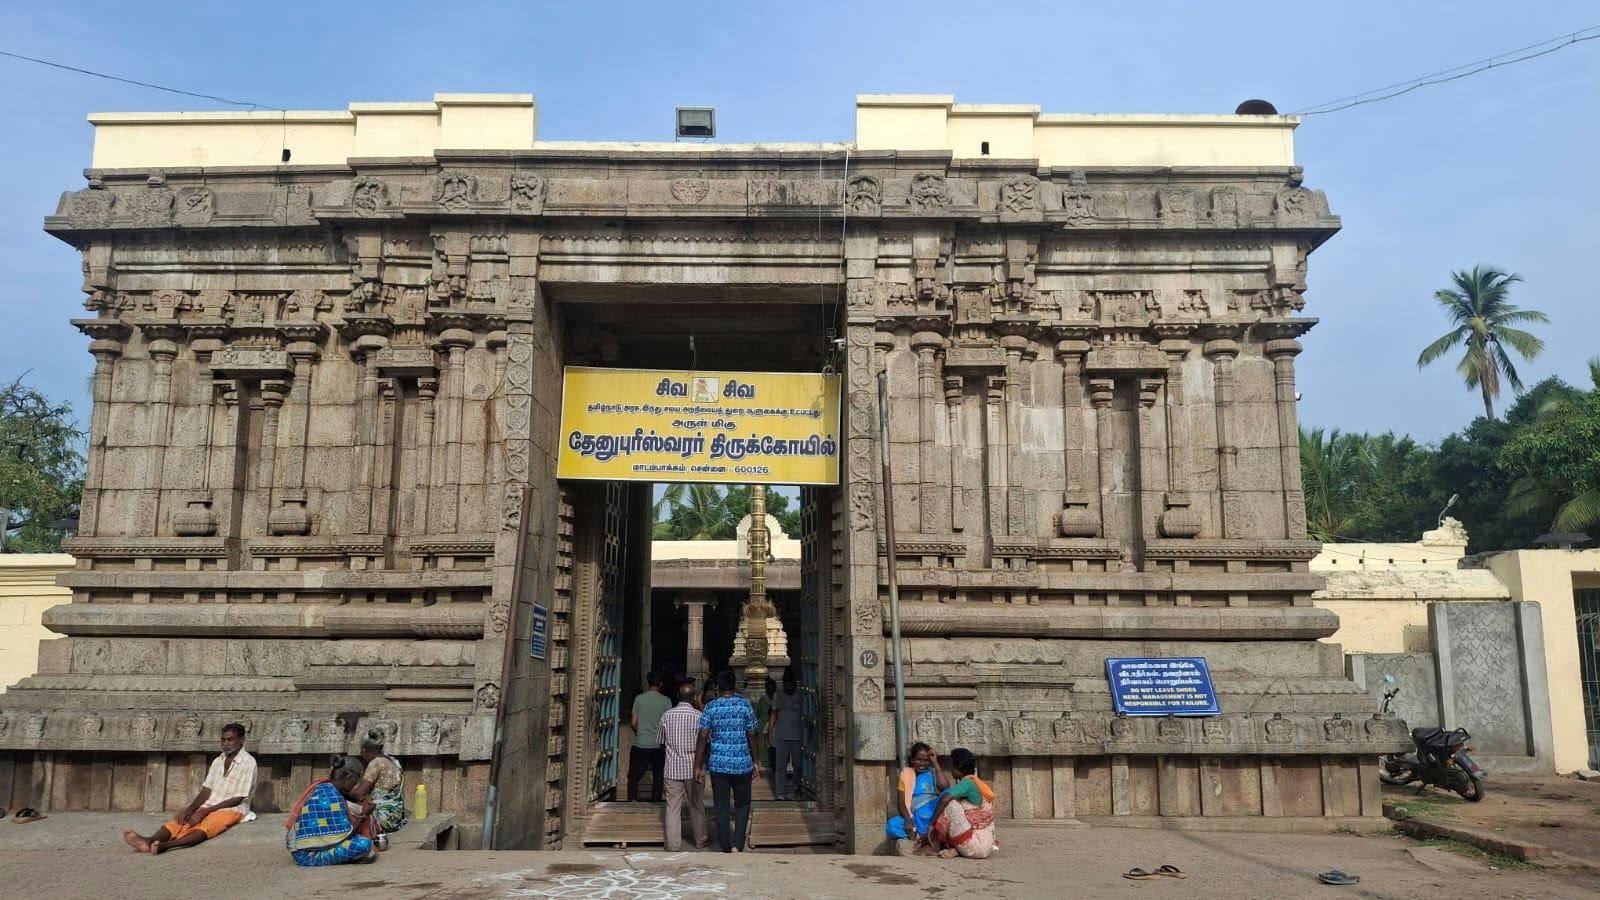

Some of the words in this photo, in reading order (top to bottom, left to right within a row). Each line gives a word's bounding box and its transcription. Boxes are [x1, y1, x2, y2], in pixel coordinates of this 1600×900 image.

[656, 377, 689, 397] சிவ
[723, 379, 756, 398] சிவ
[587, 403, 622, 414] தமிழ்நாடு
[672, 418, 708, 430] அருள்
[712, 419, 736, 430] மிகு
[568, 428, 706, 462] தேனுபுரீஸ்வரர்
[710, 432, 837, 460] திருக்கோயில்
[863, 653, 874, 665] 12
